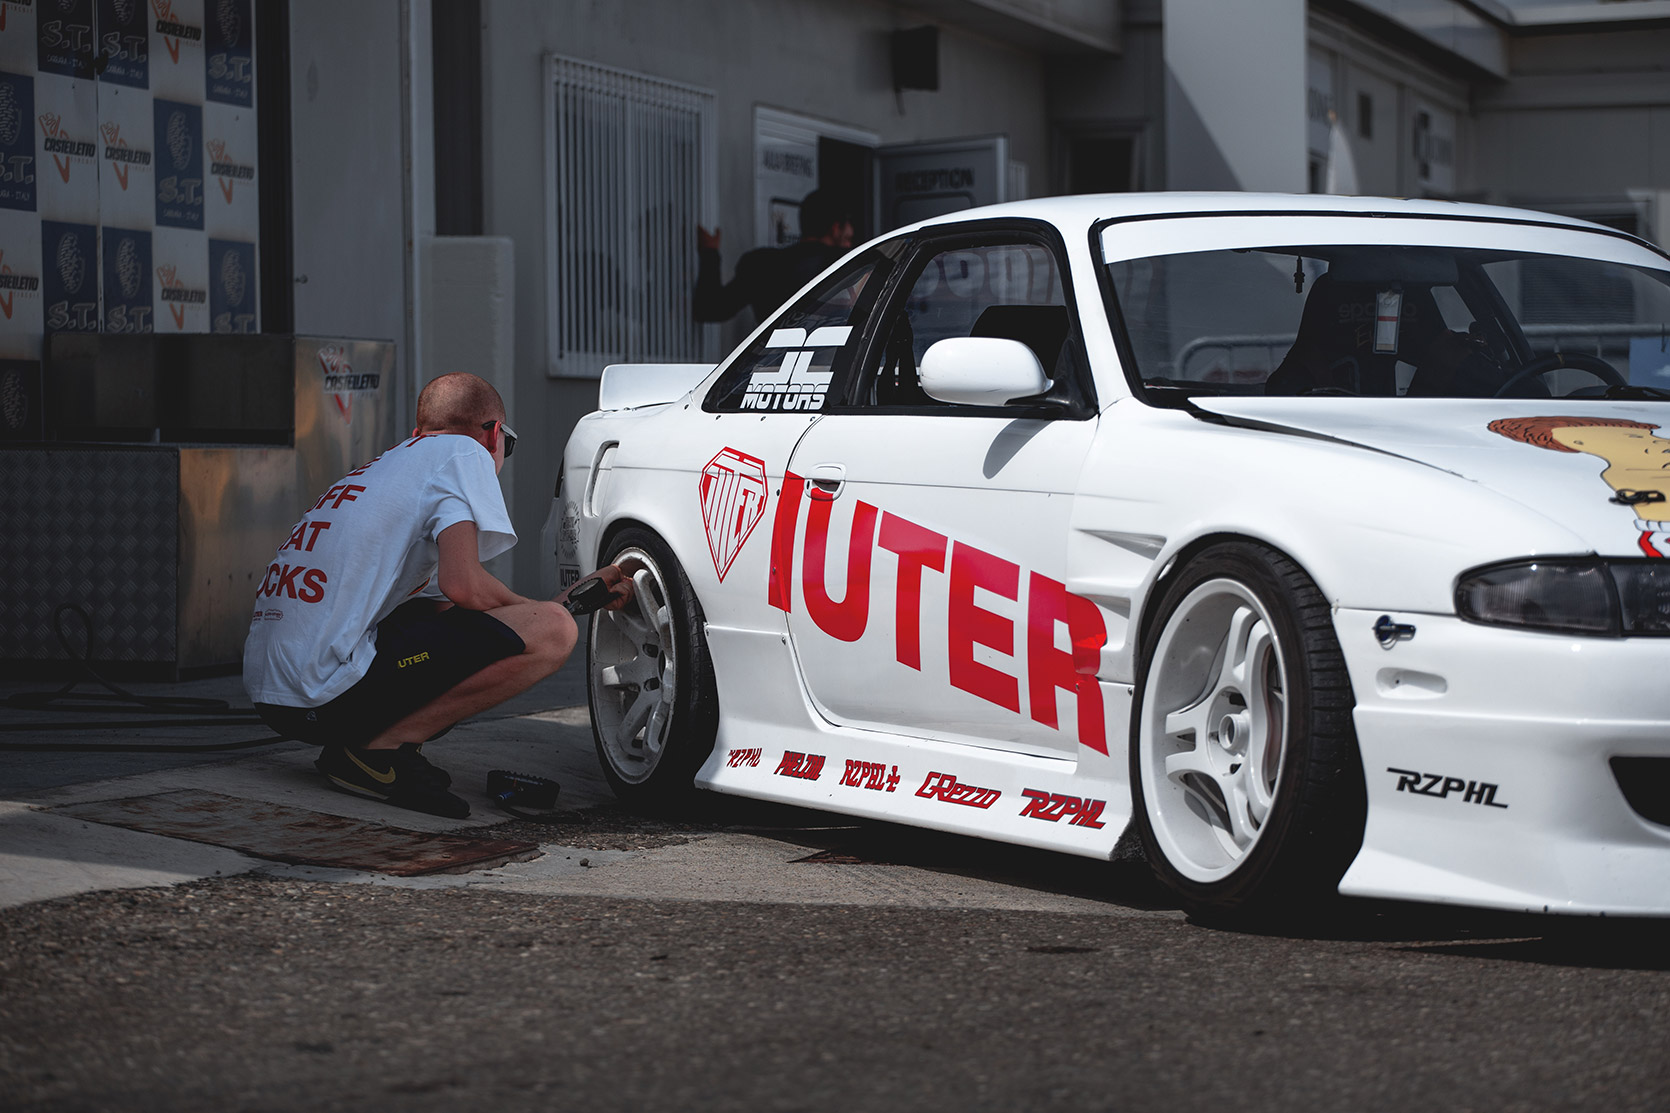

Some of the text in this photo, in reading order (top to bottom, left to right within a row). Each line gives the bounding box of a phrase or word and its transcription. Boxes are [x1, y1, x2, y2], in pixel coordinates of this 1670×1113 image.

[41, 20, 91, 53] S.T.
[156, 20, 202, 41] CASTELLETTO
[101, 31, 147, 63] S.T.
[208, 53, 252, 83] S.T.
[44, 138, 96, 158] CASTELLETTO
[105, 147, 151, 165] CASTELLETTO
[158, 175, 202, 206] S.T.
[0, 274, 39, 291] STELLETTO
[48, 300, 97, 330] S.T.
[107, 304, 152, 333] S.T.
[324, 374, 380, 391] CASTELLETTO
[739, 383, 830, 410] MOTORS
[304, 485, 366, 514] FF
[278, 521, 331, 552] AT
[768, 471, 1110, 757] IUTER
[397, 651, 430, 669] UTER
[1386, 766, 1509, 809] RZPHL
[1018, 787, 1107, 830] RZPHL
